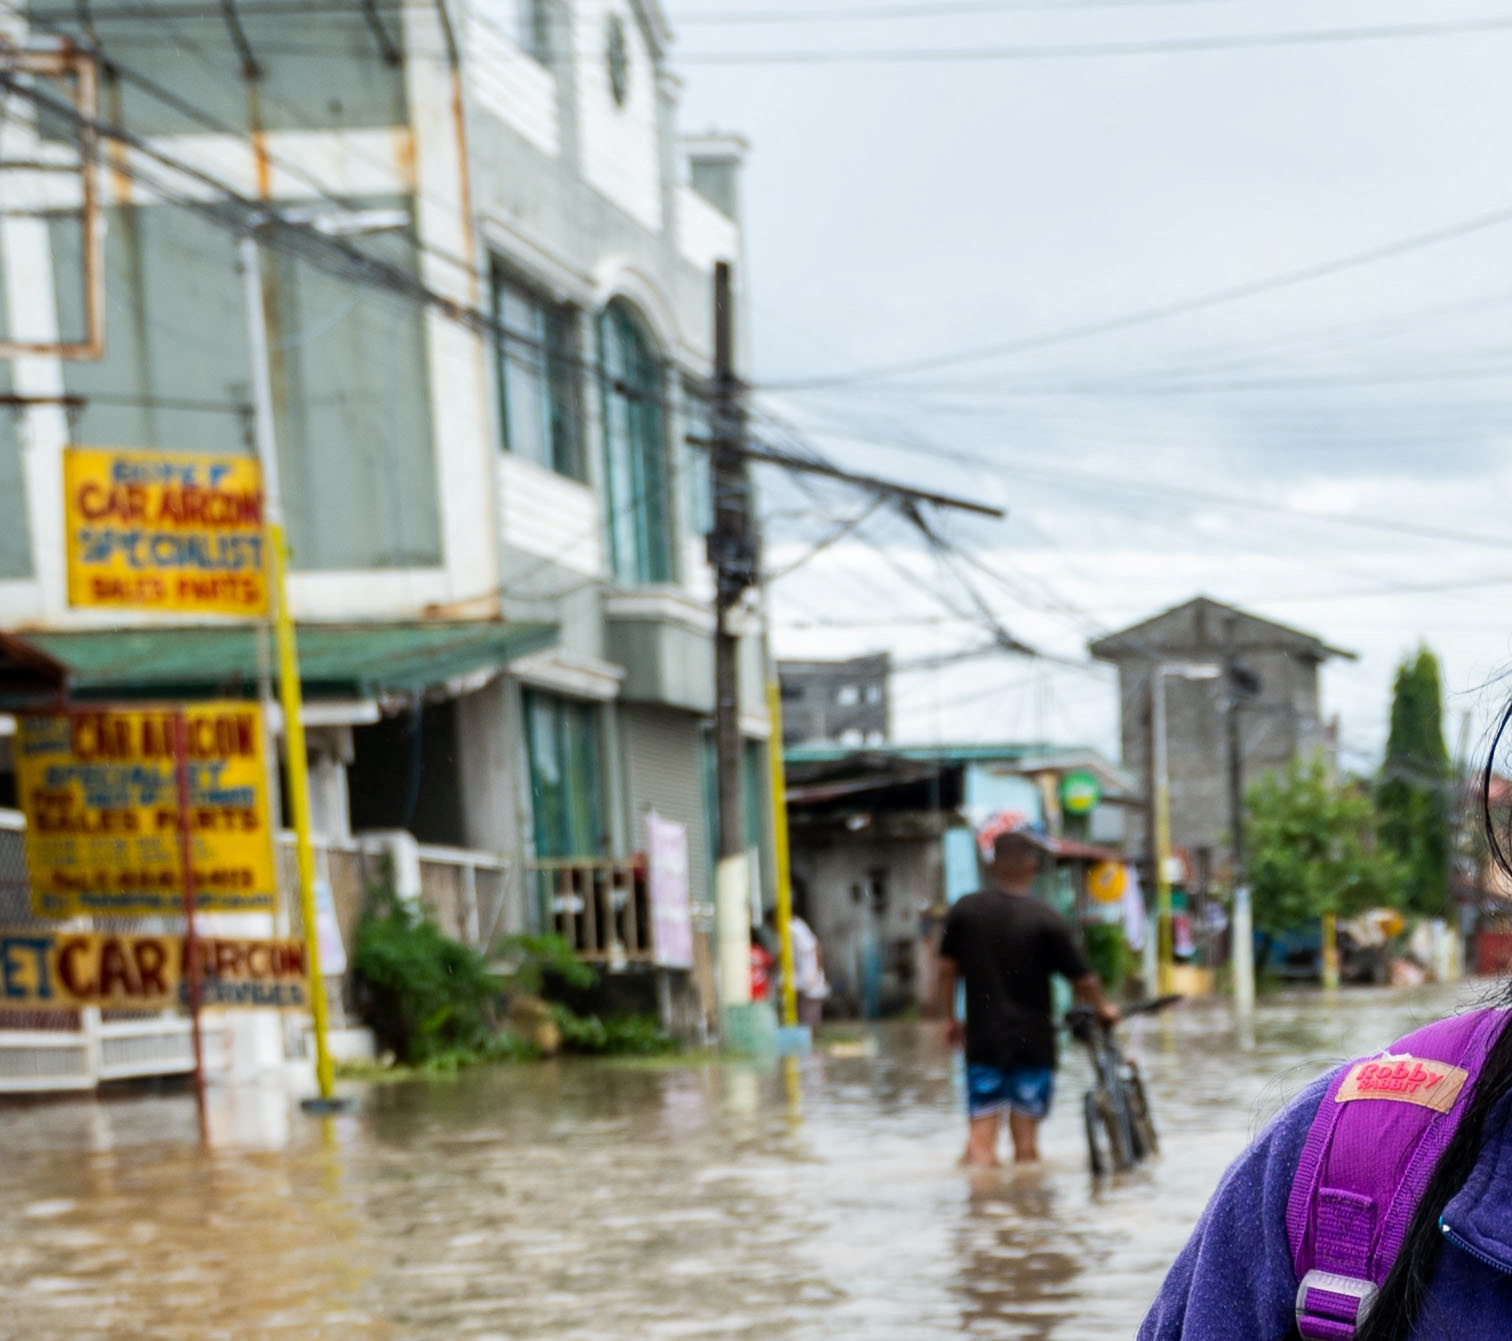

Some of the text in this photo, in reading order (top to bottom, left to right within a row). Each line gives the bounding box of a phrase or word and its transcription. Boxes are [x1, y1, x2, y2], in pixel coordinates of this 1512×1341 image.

[77, 529, 264, 573] SPECIALIST
[57, 936, 170, 1000] CAR
[1355, 1060, 1444, 1090] Robby
[1356, 1078, 1422, 1094] RABBIT
